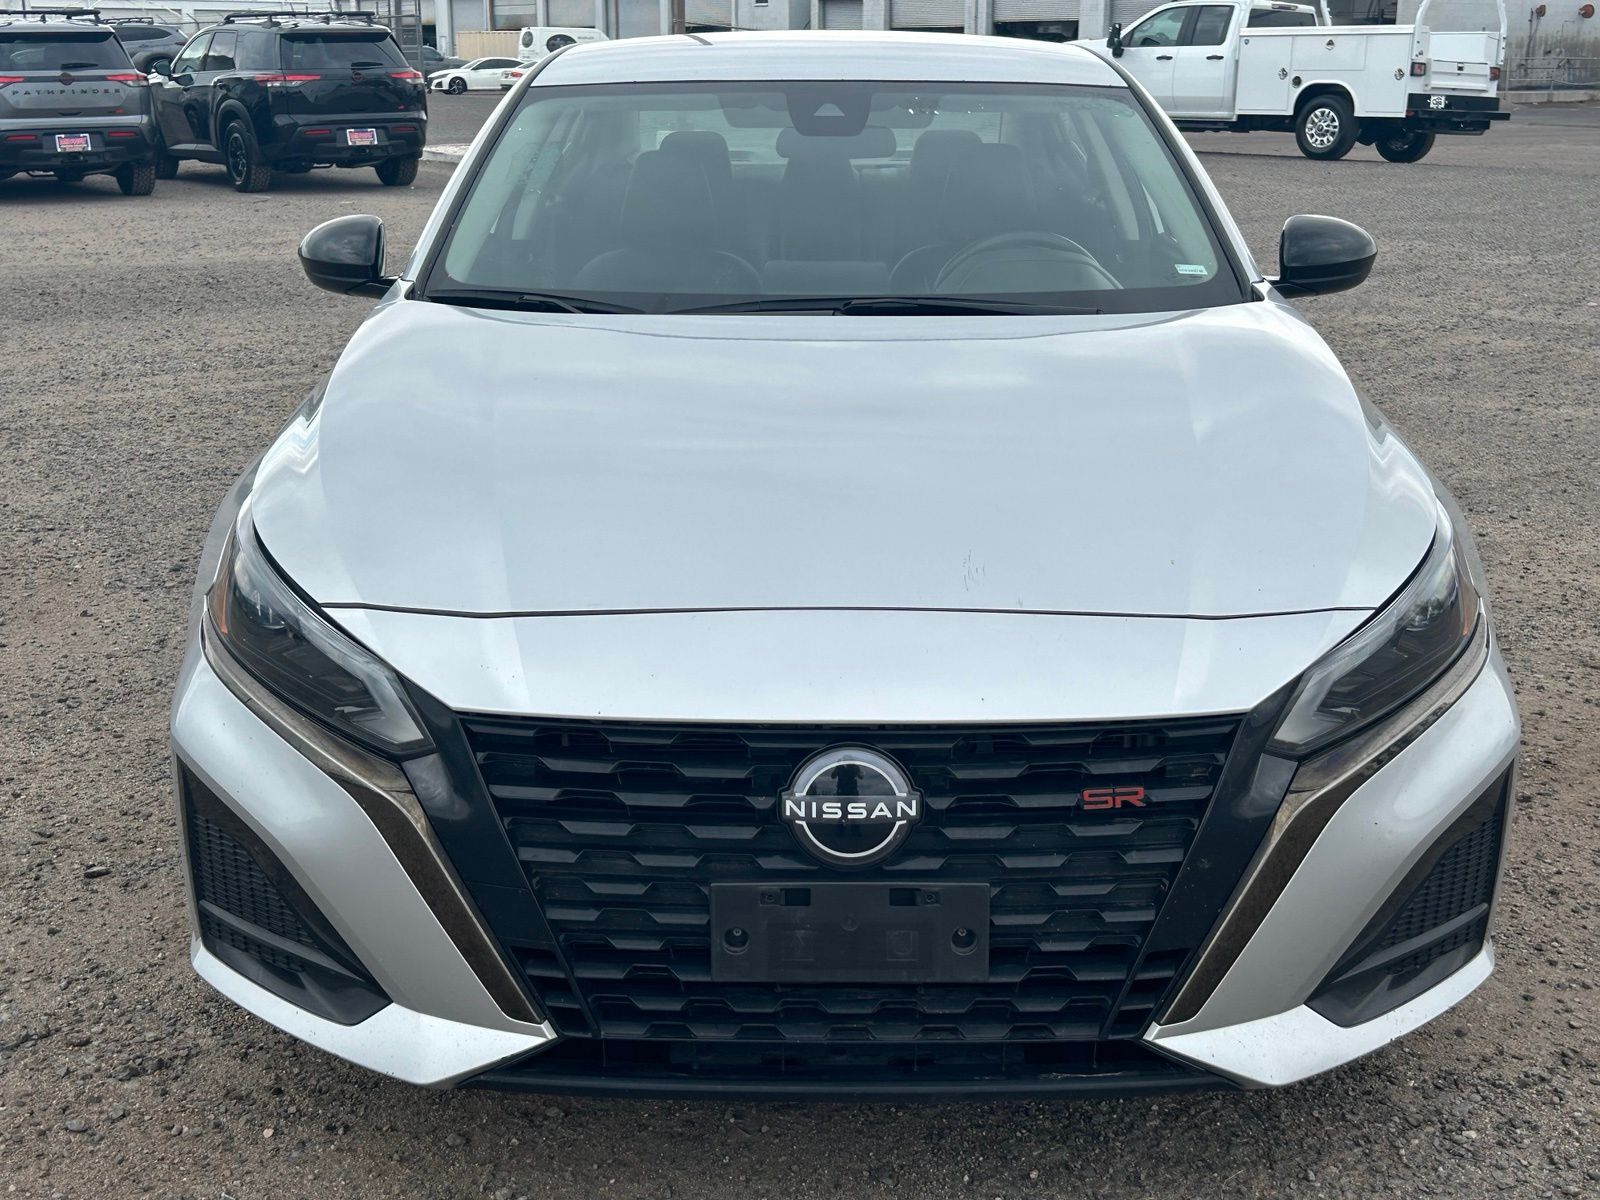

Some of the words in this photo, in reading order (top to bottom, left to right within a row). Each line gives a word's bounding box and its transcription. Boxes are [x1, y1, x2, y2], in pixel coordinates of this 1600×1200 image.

[12, 88, 121, 96] PATHFINDER
[1083, 787, 1146, 810] SR
[785, 799, 917, 819] NISSAN
